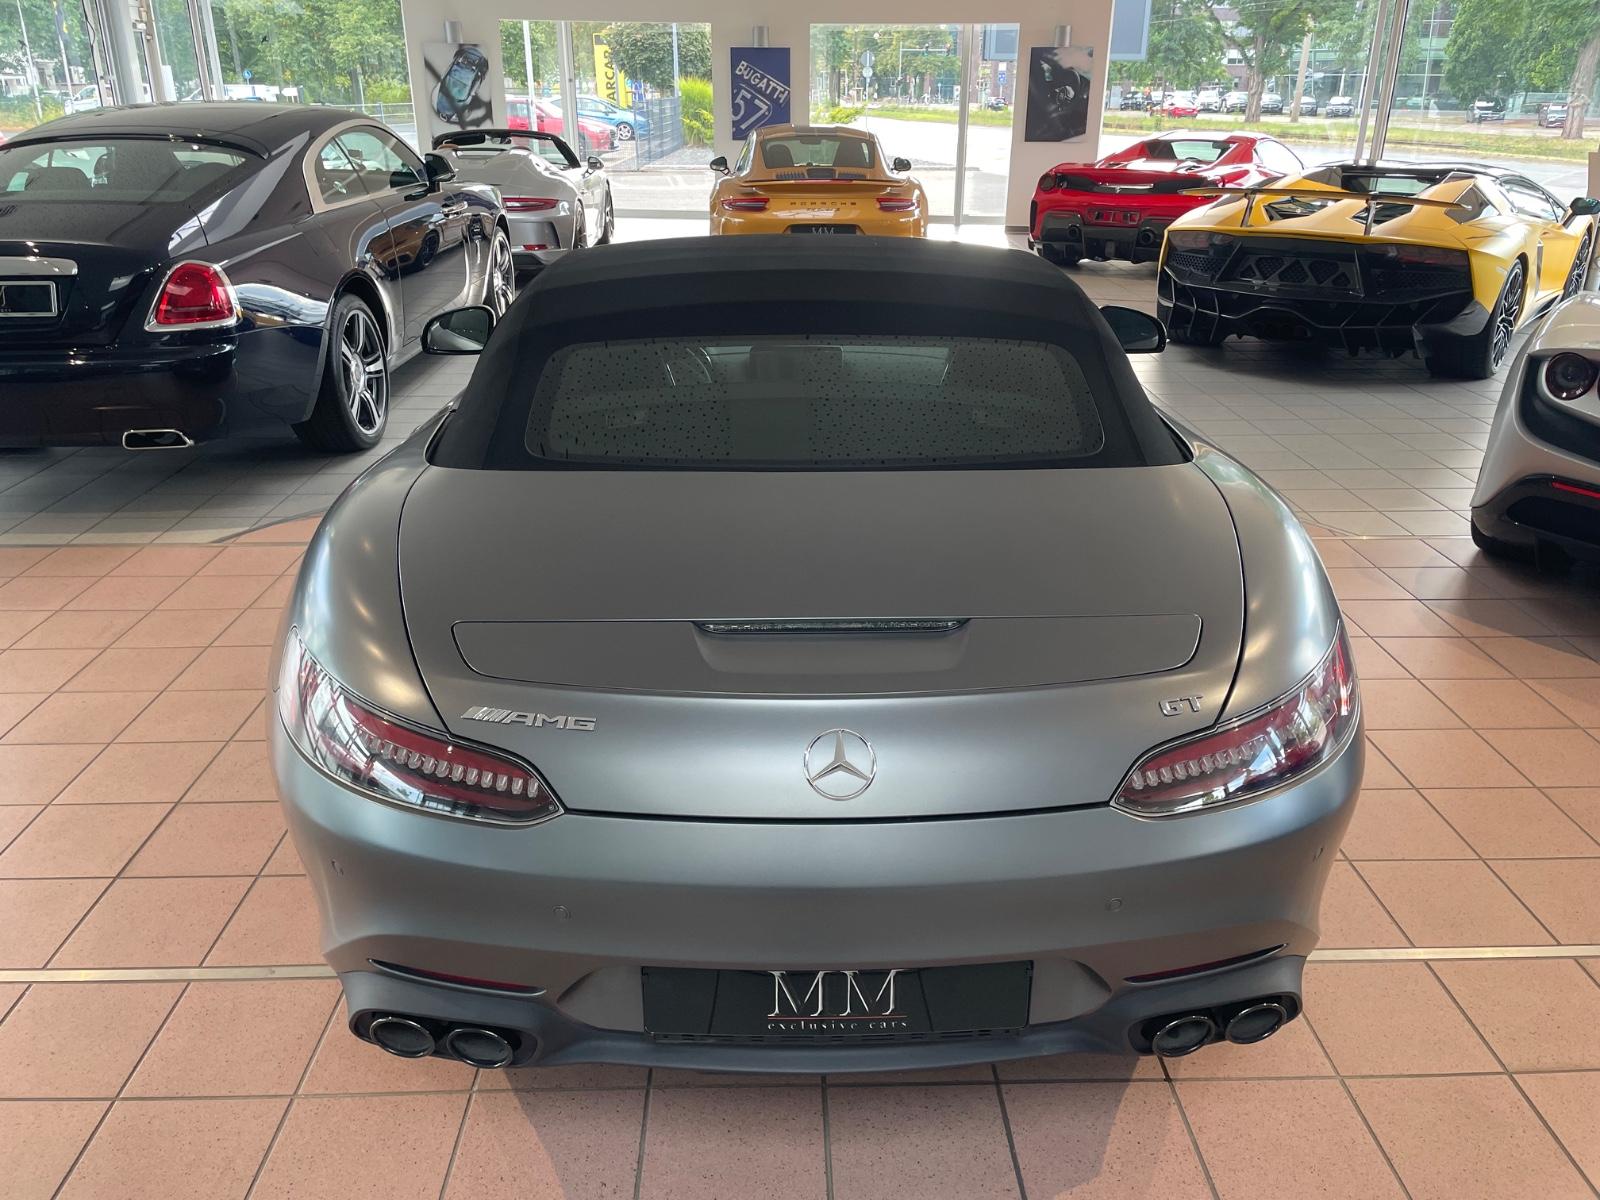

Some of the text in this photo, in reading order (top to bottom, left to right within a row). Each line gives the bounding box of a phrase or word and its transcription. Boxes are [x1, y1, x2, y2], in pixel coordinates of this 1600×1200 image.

[735, 60, 789, 104] BUGATTI
[732, 89, 769, 131] 57
[501, 709, 597, 731] AMG
[1159, 695, 1204, 717] GT
[767, 968, 908, 1017] MM
[767, 1020, 908, 1031] exclusive cars
